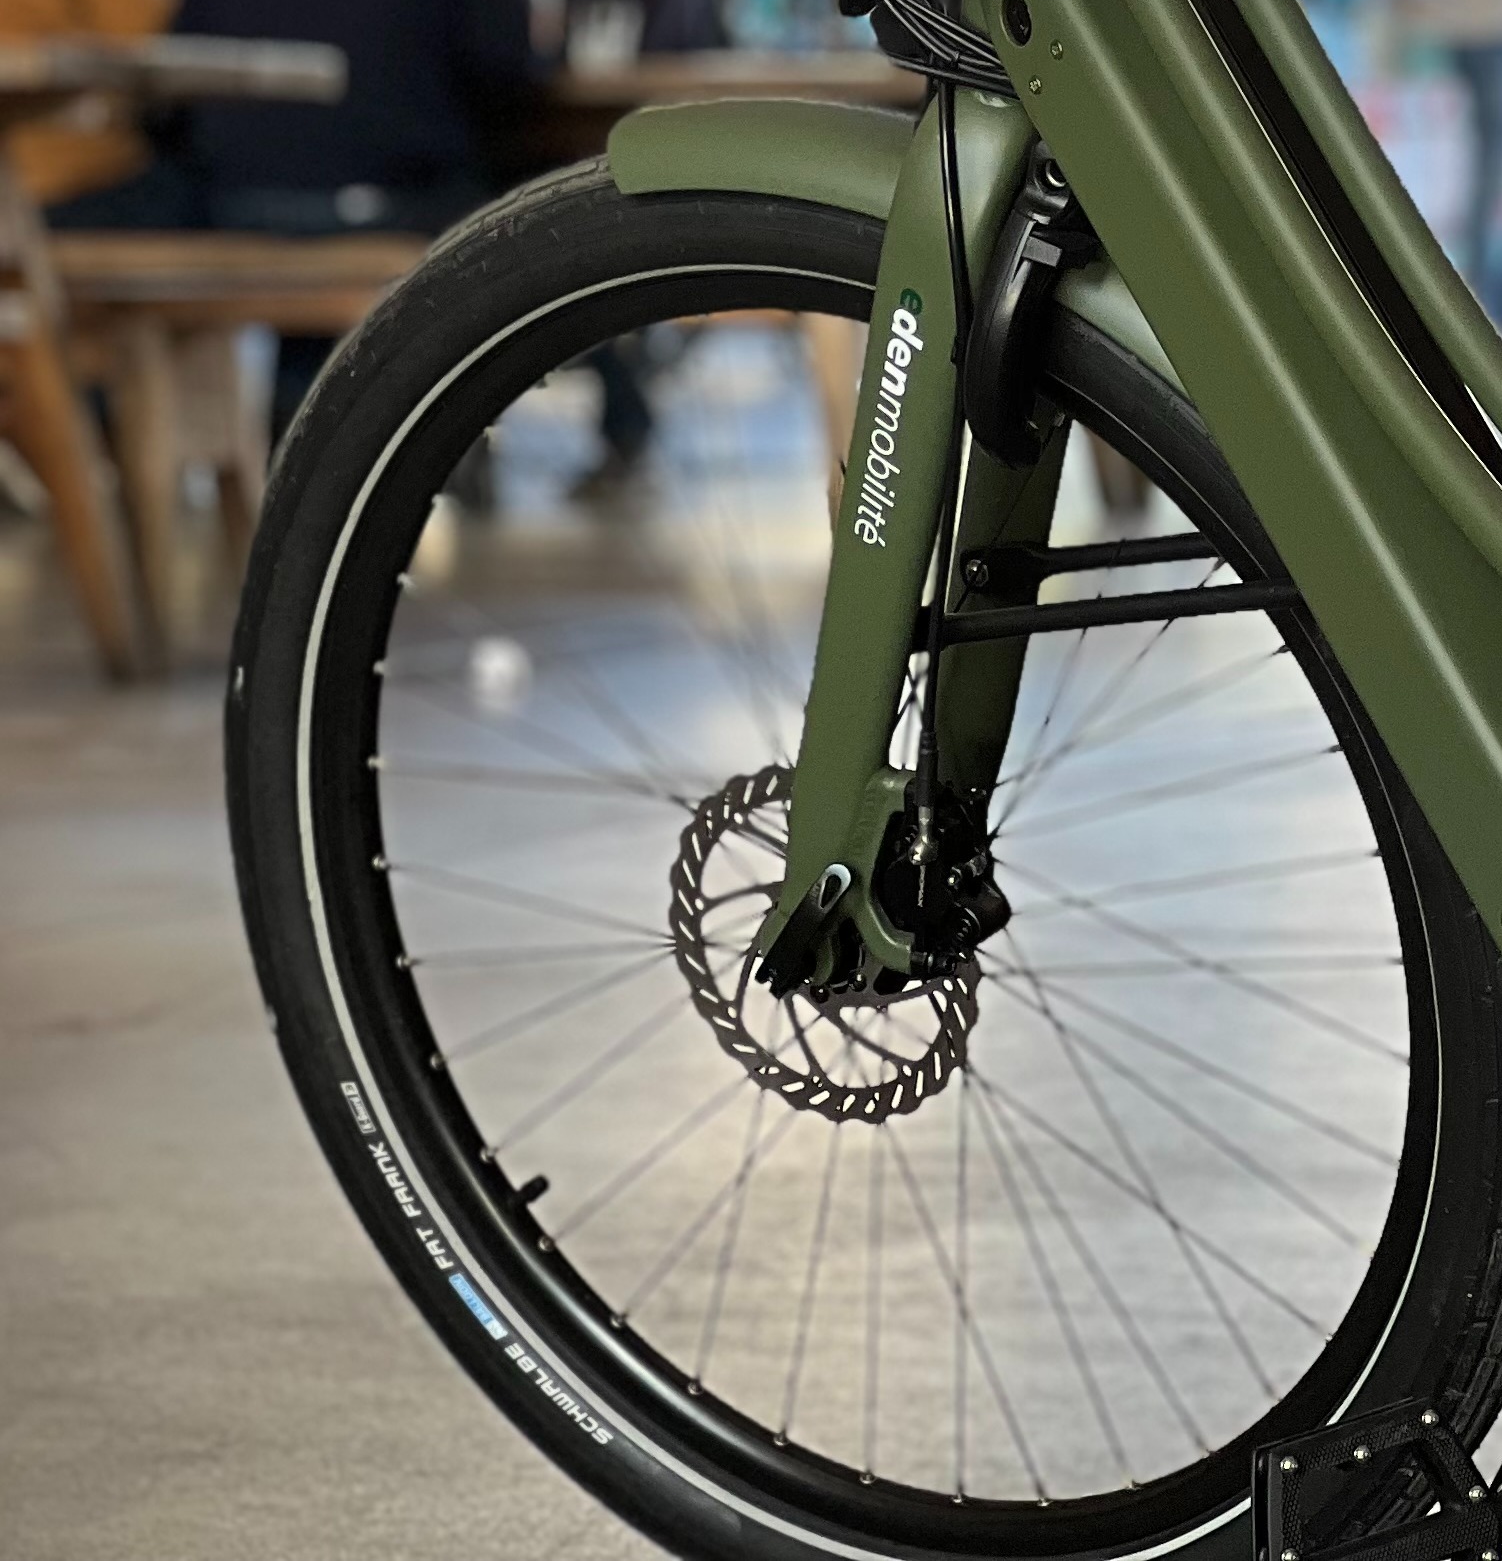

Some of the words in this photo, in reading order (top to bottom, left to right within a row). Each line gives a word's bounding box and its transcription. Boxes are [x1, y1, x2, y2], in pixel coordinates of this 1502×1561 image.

[854, 288, 923, 547] edenmobilité
[368, 1142, 421, 1218] FRANK
[416, 1227, 454, 1270] FAT
[505, 1342, 614, 1445] SCHWALBE
